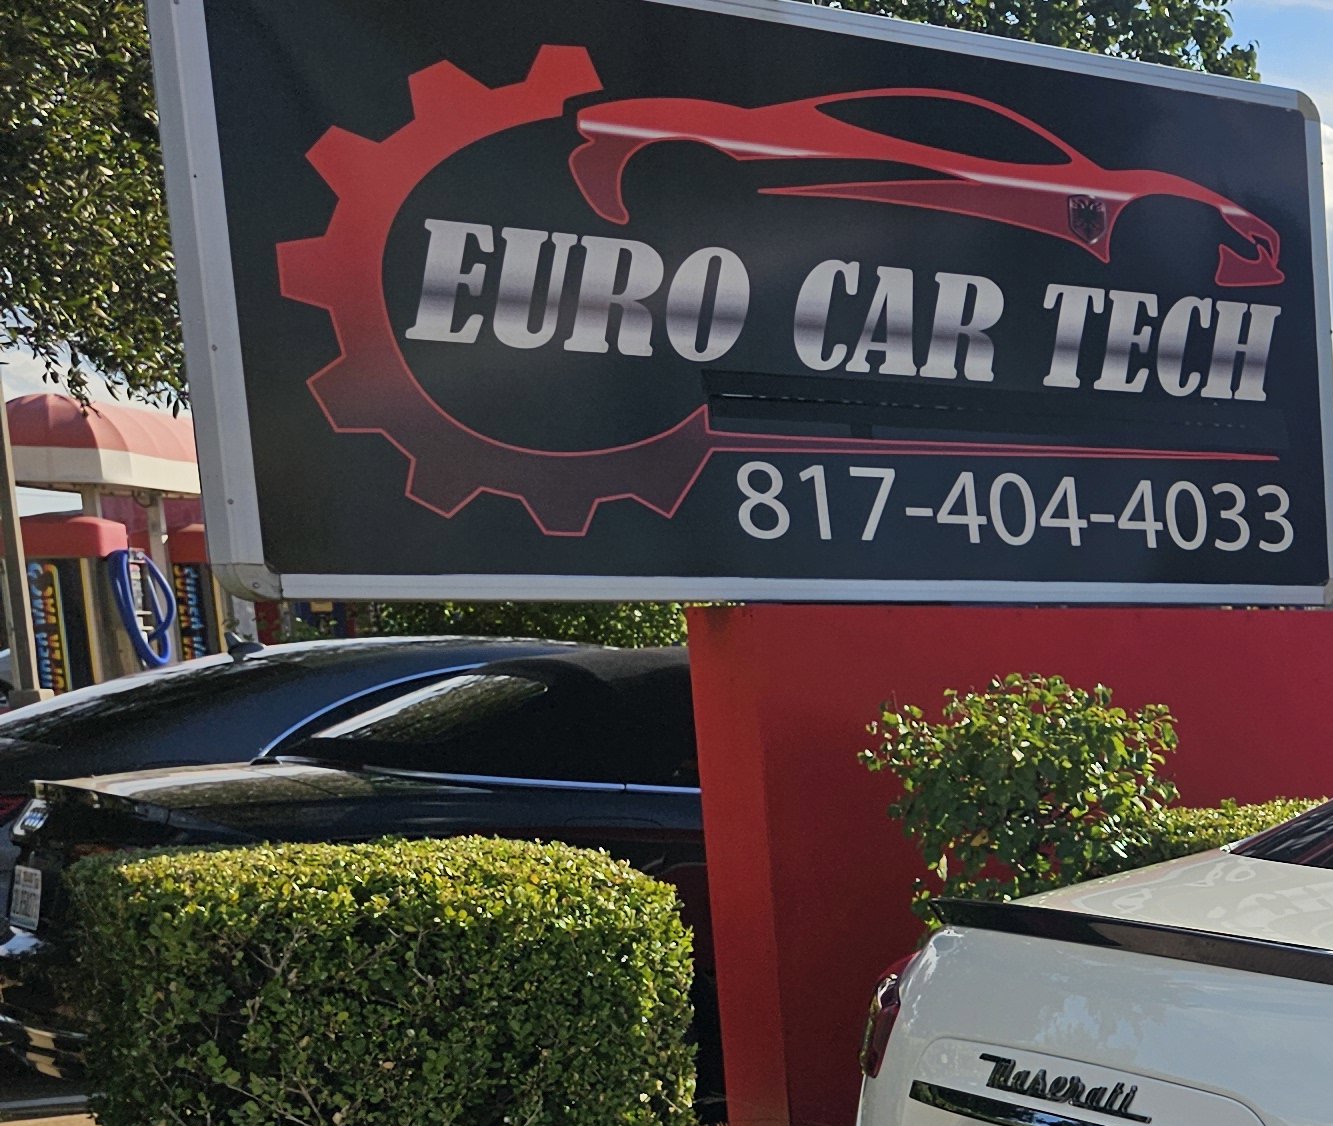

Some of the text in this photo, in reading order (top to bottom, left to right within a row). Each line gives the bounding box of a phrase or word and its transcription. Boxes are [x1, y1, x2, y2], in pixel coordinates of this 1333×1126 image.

[405, 217, 1282, 402] EURO CAR TECH
[736, 460, 1295, 553] 817-404-4033
[35, 632, 66, 694] UPER
[183, 635, 206, 660] VA
[979, 1053, 1152, 1124] Maserati
